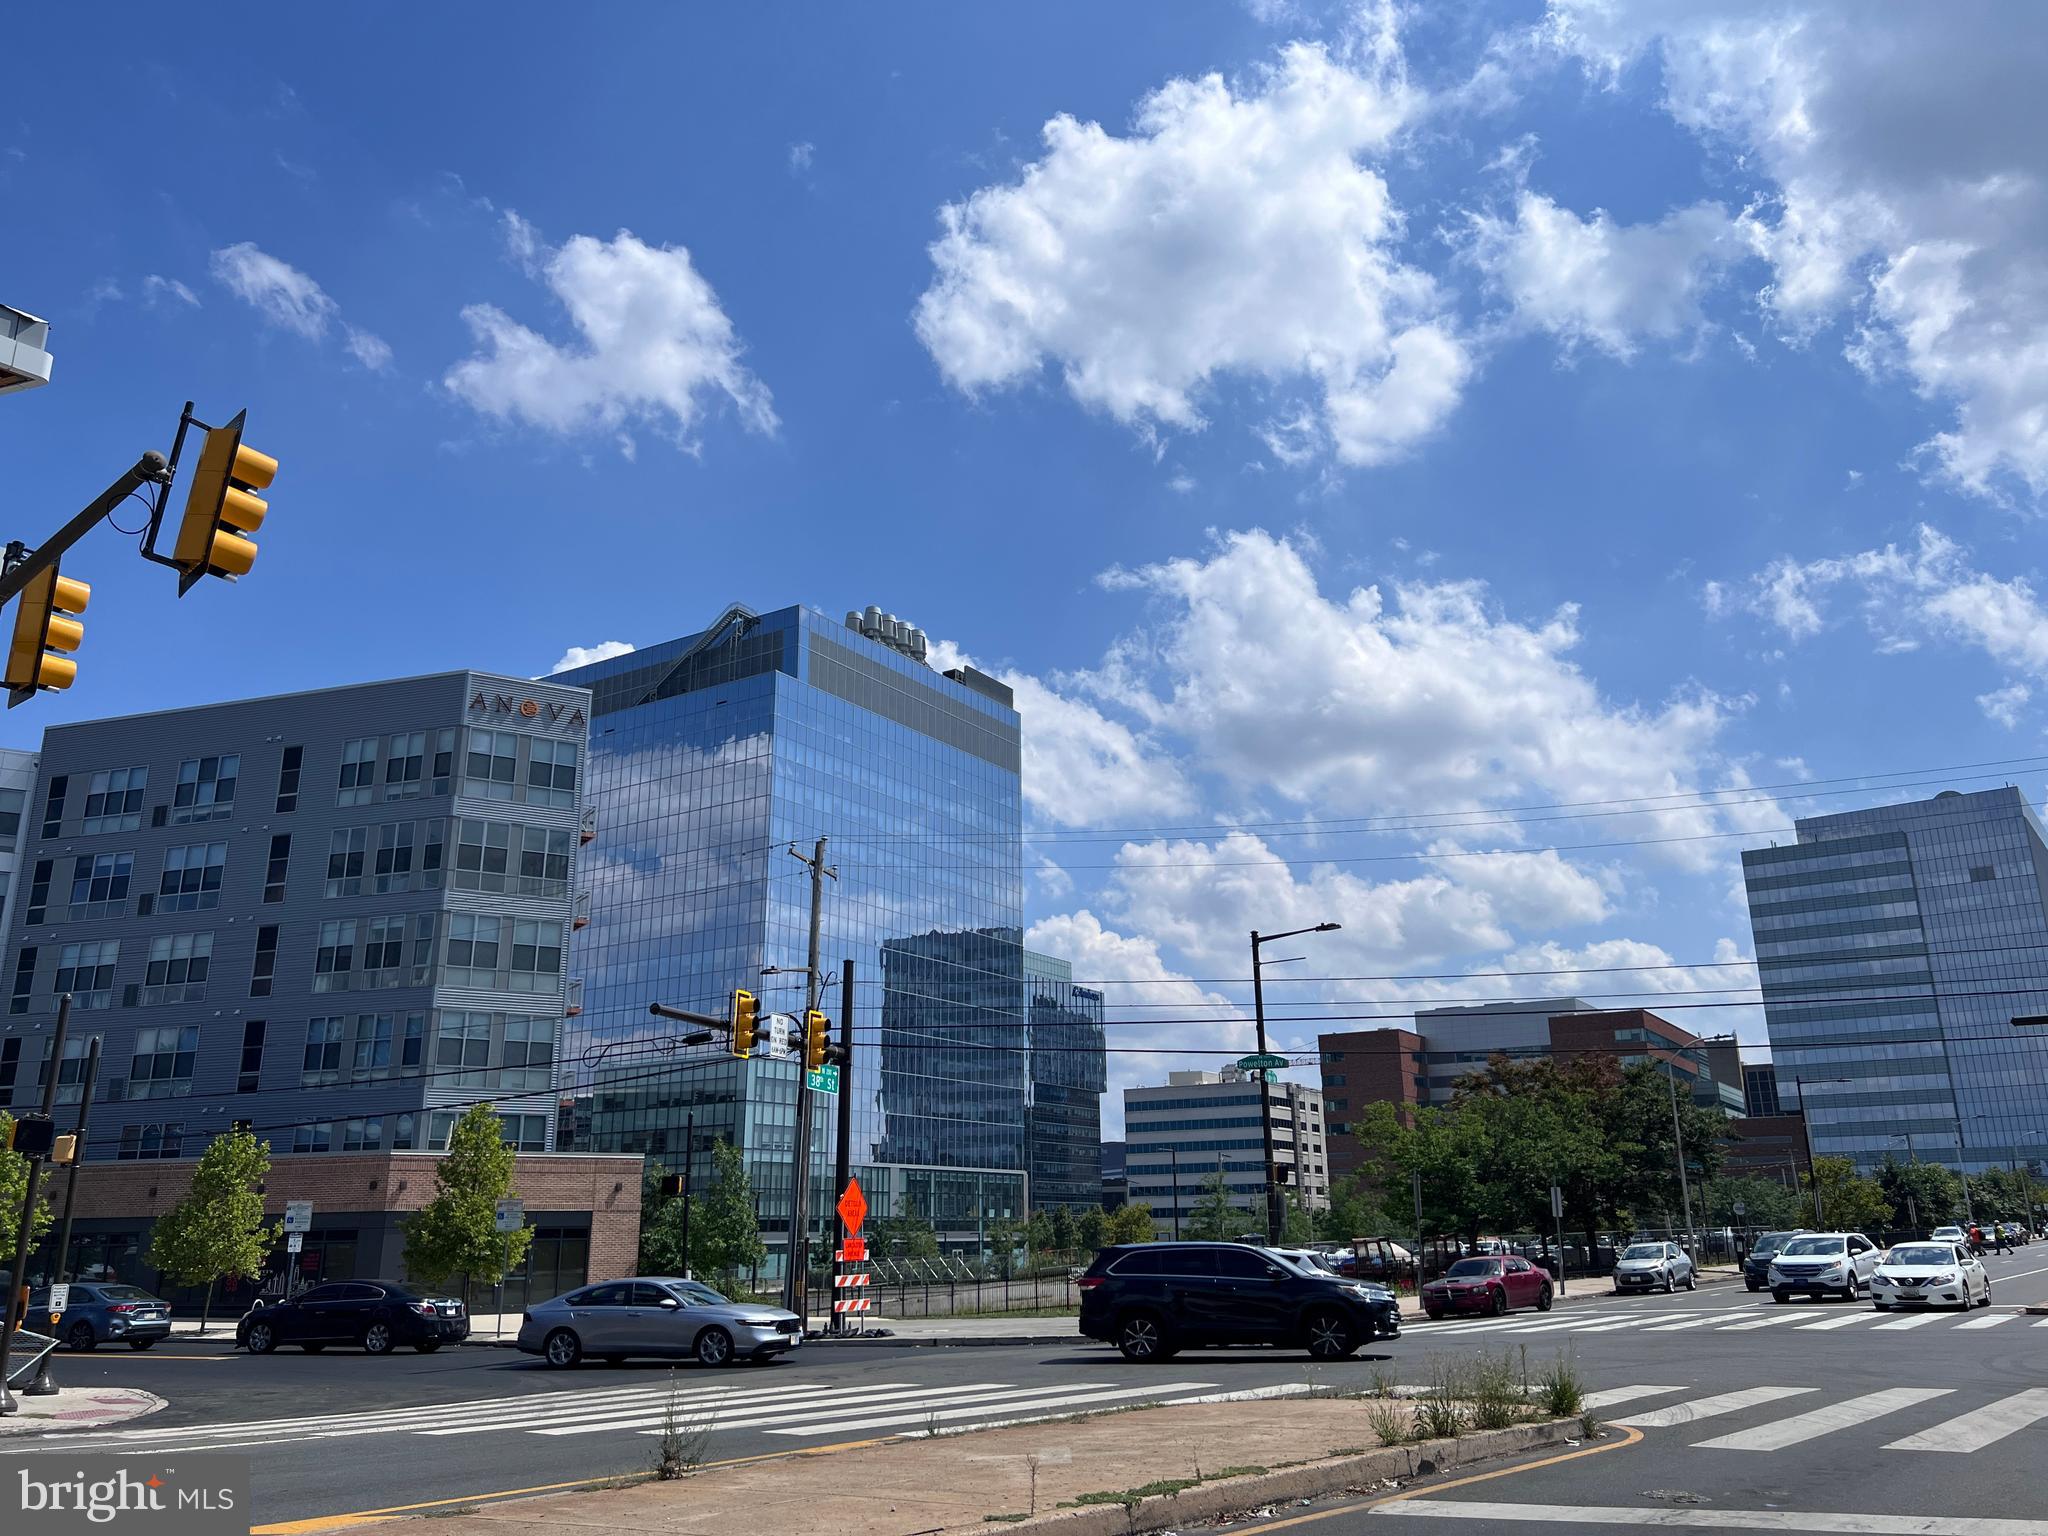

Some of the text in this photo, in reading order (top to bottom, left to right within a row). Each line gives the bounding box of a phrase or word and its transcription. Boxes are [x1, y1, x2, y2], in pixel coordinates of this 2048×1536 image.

[469, 692, 586, 724] ANOVA
[776, 1017, 784, 1026] NO
[774, 1026, 785, 1035] TURN
[779, 1037, 787, 1046] RED
[1238, 1060, 1273, 1068] Powelton
[827, 1078, 835, 1091] St
